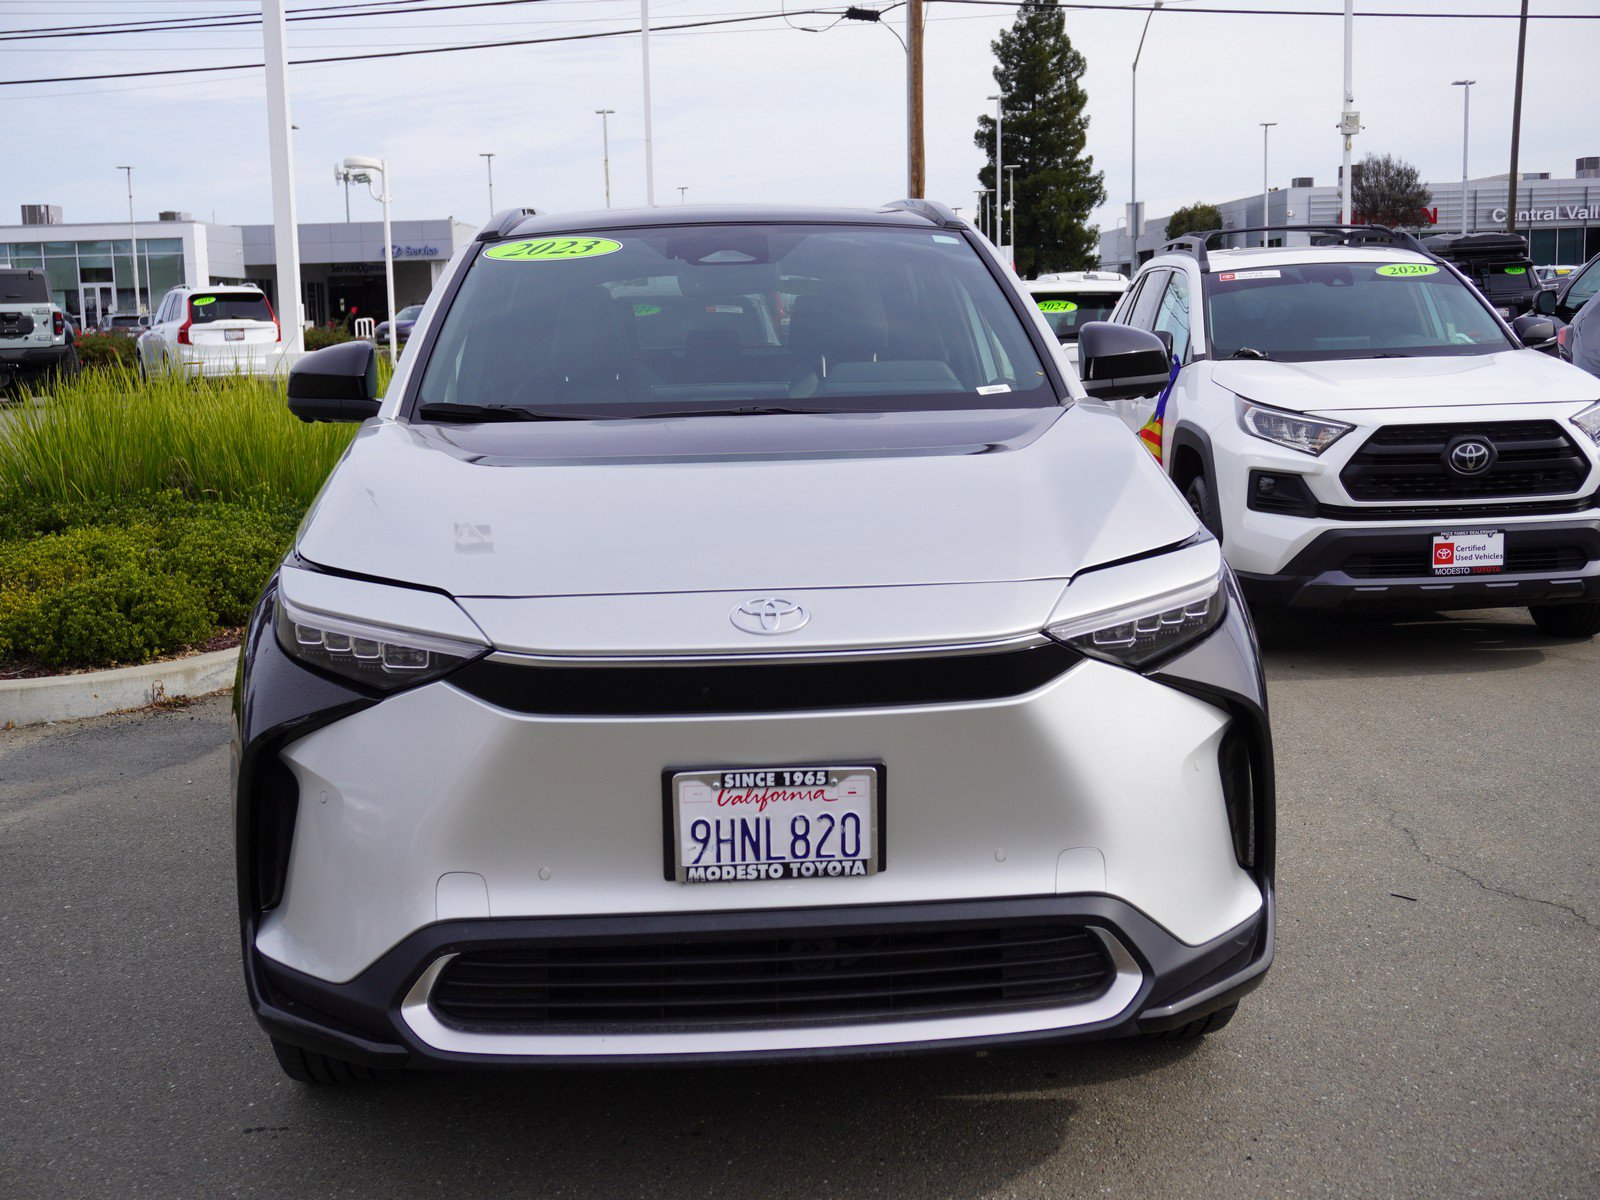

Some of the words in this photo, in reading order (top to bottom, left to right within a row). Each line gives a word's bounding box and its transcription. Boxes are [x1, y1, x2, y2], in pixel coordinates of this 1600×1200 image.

[1492, 206, 1559, 223] Cntral
[405, 246, 439, 257] Service
[501, 240, 602, 257] 2023
[1389, 265, 1428, 275] 2020
[1040, 302, 1069, 311] 2024
[1455, 544, 1486, 552] Certified
[1434, 567, 1470, 575] MODESTO
[724, 772, 775, 788] SINCE
[783, 771, 827, 786] 1965
[717, 787, 839, 812] California
[690, 812, 861, 865] 9HNL820
[687, 863, 784, 882] MODESTO
[789, 860, 868, 877] TOYOTA
